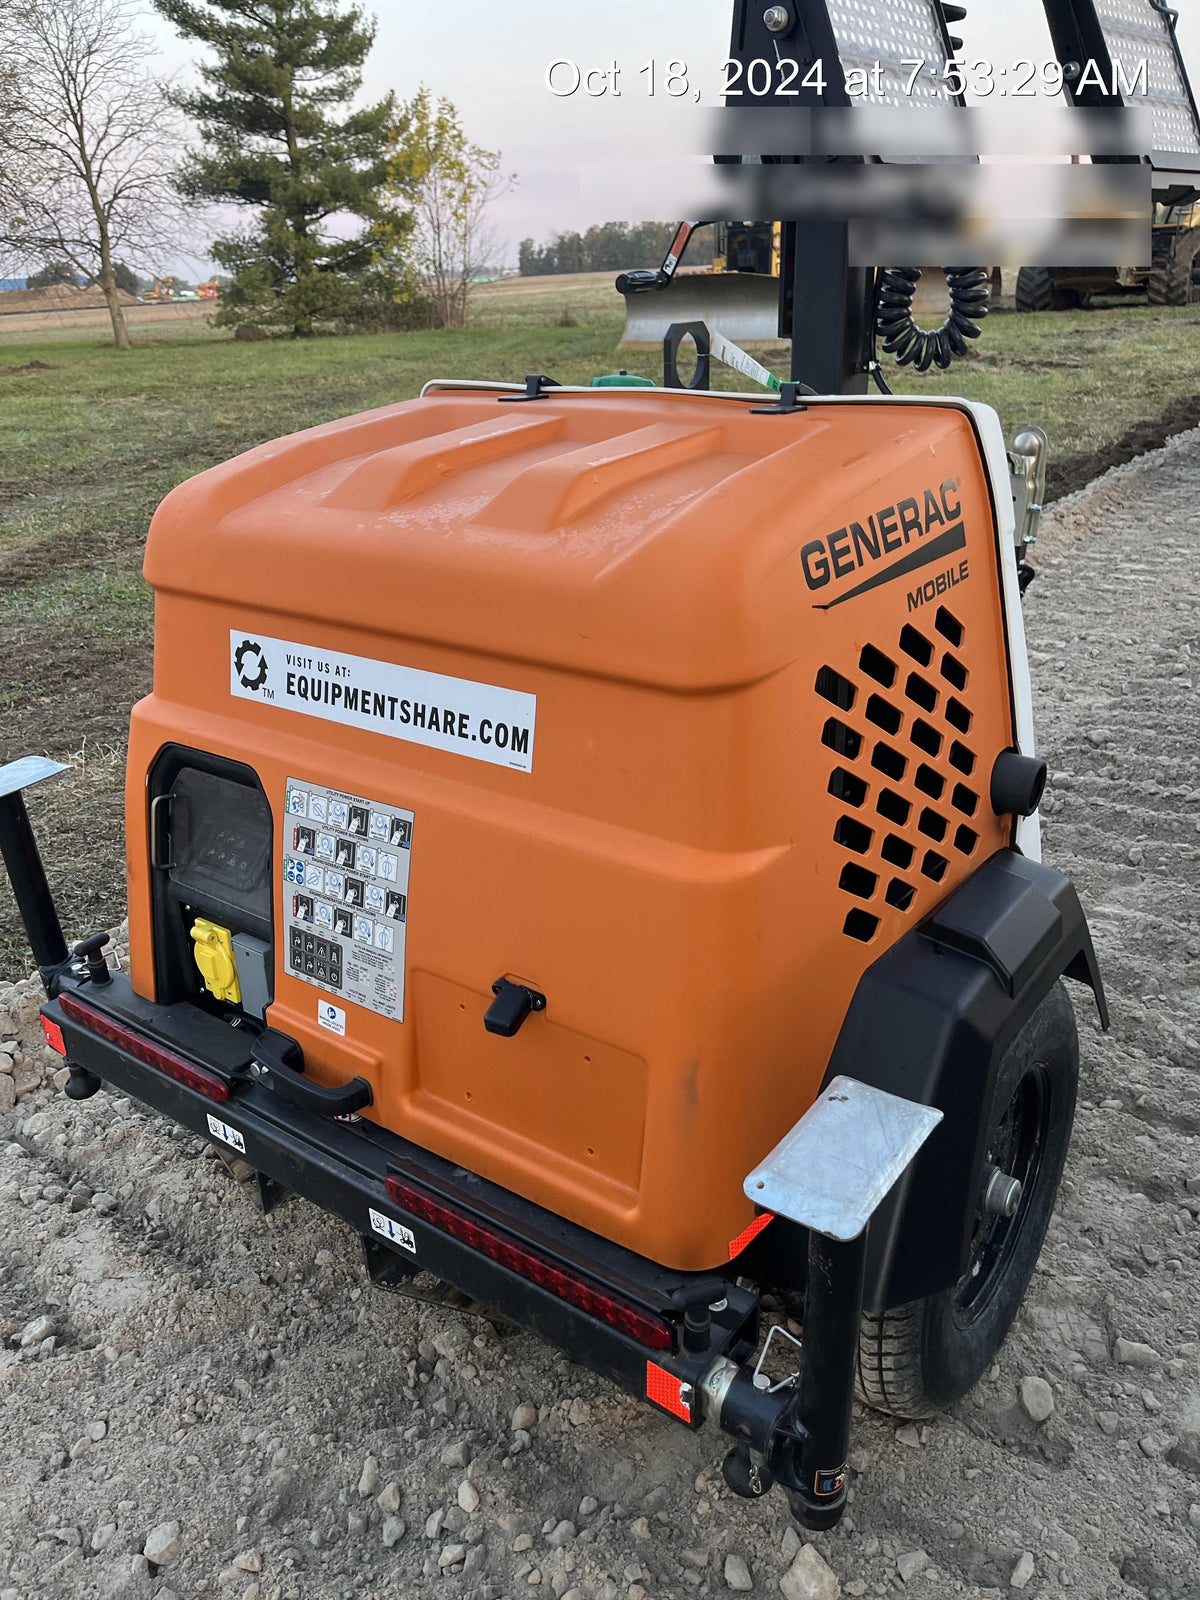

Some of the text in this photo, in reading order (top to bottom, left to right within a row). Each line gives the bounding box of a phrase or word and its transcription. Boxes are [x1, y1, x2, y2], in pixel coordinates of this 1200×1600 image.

[800, 477, 962, 591] GENERAC
[906, 559, 970, 613] MOBILE
[262, 687, 275, 699] TM
[286, 654, 351, 678] VISIT US AT:
[286, 672, 529, 754] EQUIPMENTSHARE.COM
